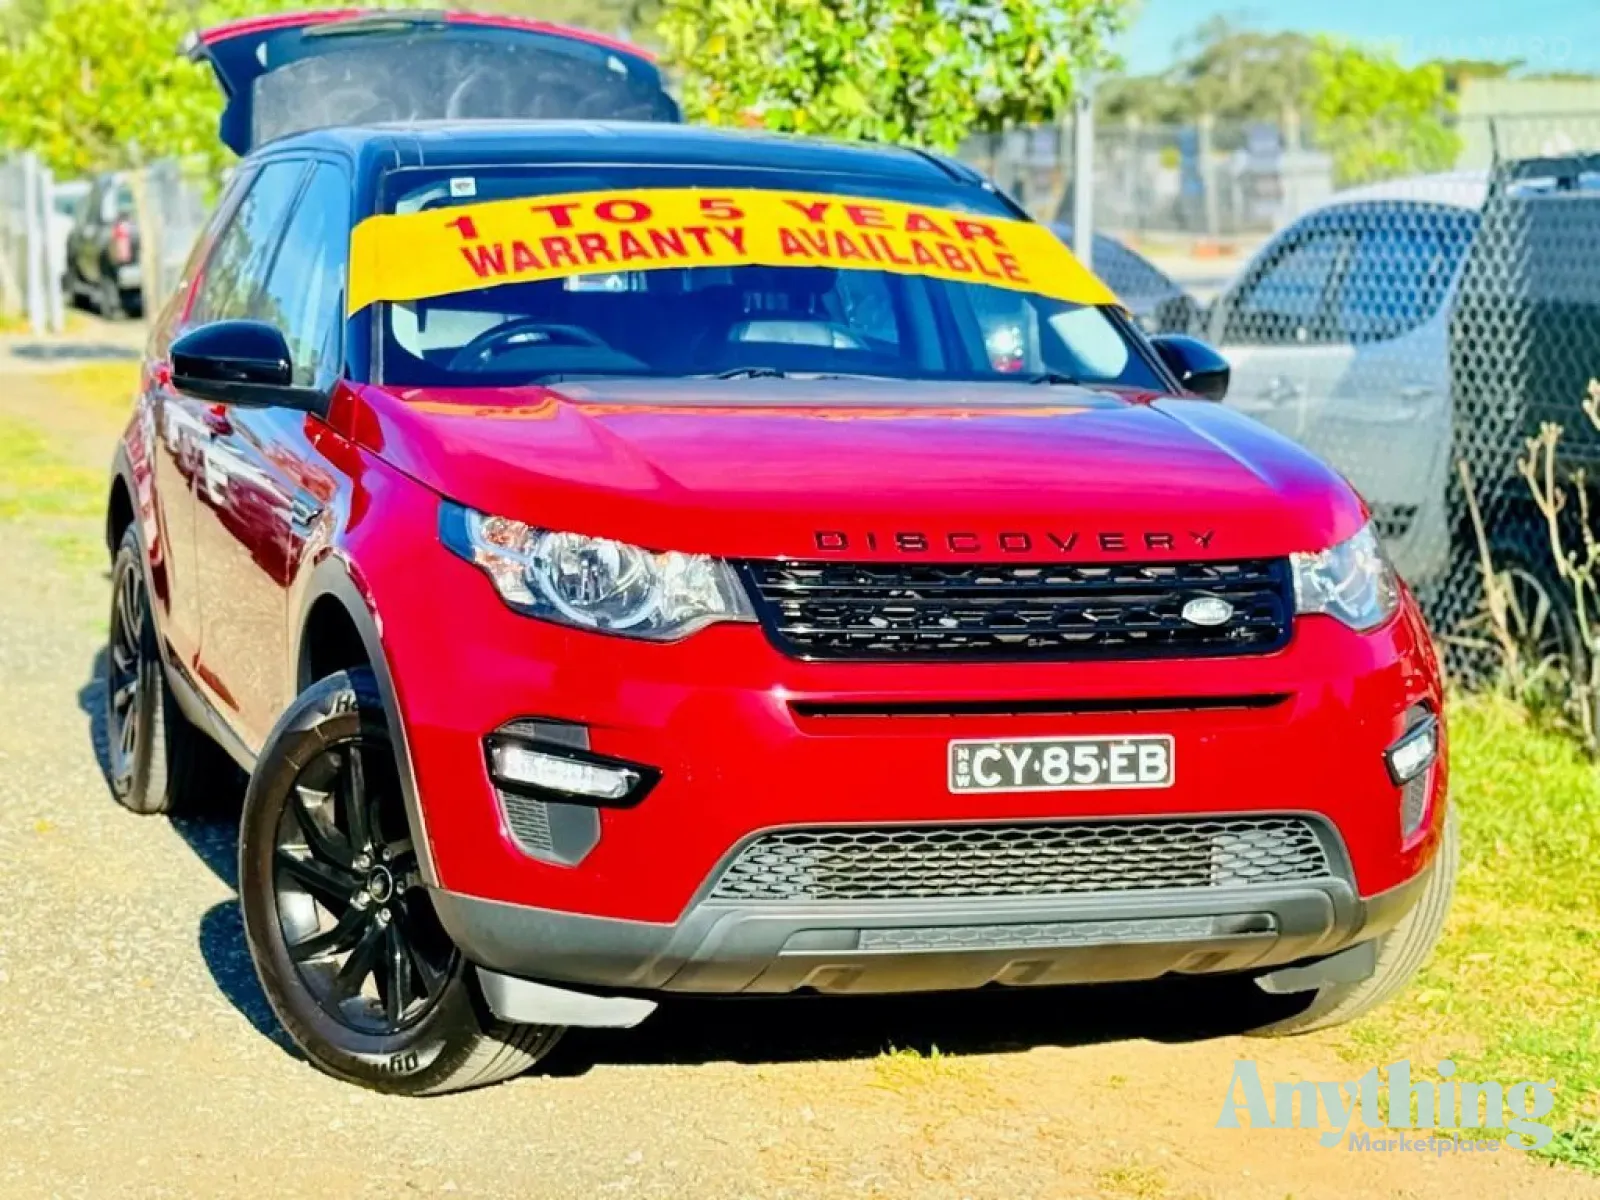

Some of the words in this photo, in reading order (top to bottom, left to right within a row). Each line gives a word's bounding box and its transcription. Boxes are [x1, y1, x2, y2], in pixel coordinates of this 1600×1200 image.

[444, 215, 478, 240] 1
[530, 199, 653, 229] TO
[699, 197, 745, 221] 5
[781, 199, 1006, 247] YEAR
[460, 226, 747, 278] WARRANTY
[778, 227, 1031, 283] AVAILABLE
[813, 530, 1216, 553] DISCOVERY
